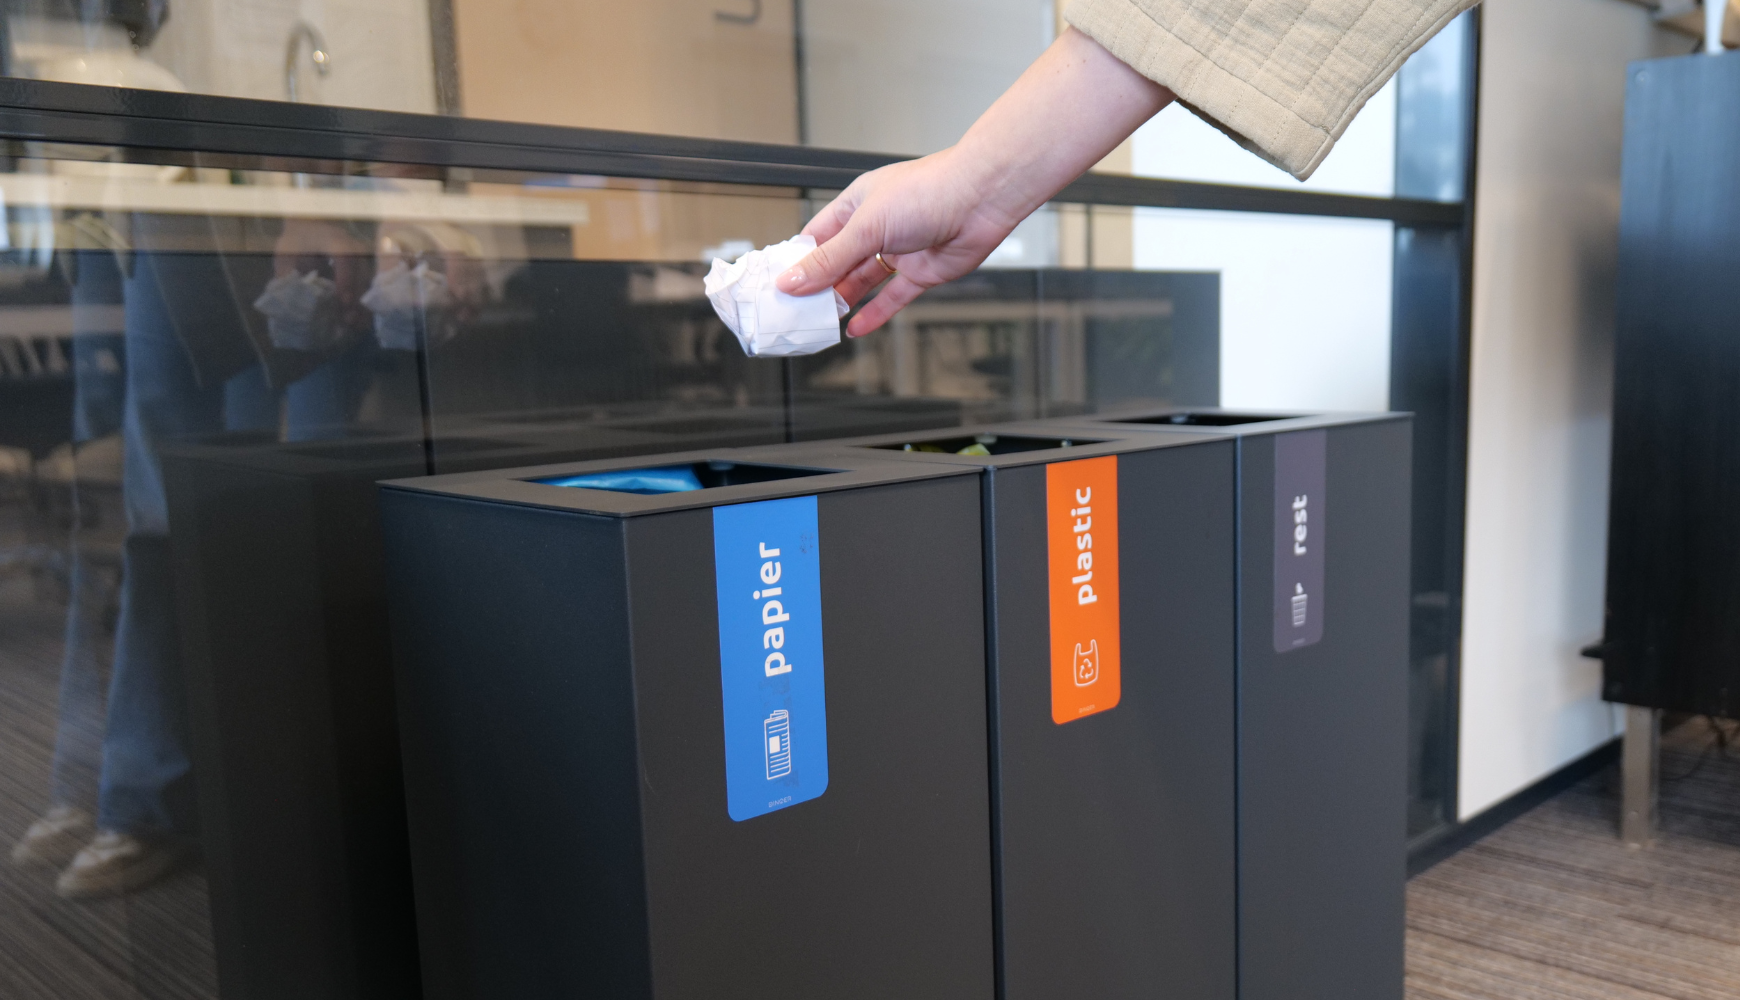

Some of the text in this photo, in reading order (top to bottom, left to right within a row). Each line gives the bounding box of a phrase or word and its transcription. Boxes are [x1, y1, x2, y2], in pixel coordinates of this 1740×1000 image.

[1071, 486, 1098, 606] plastic
[1291, 494, 1308, 556] rest
[753, 542, 792, 678] papier
